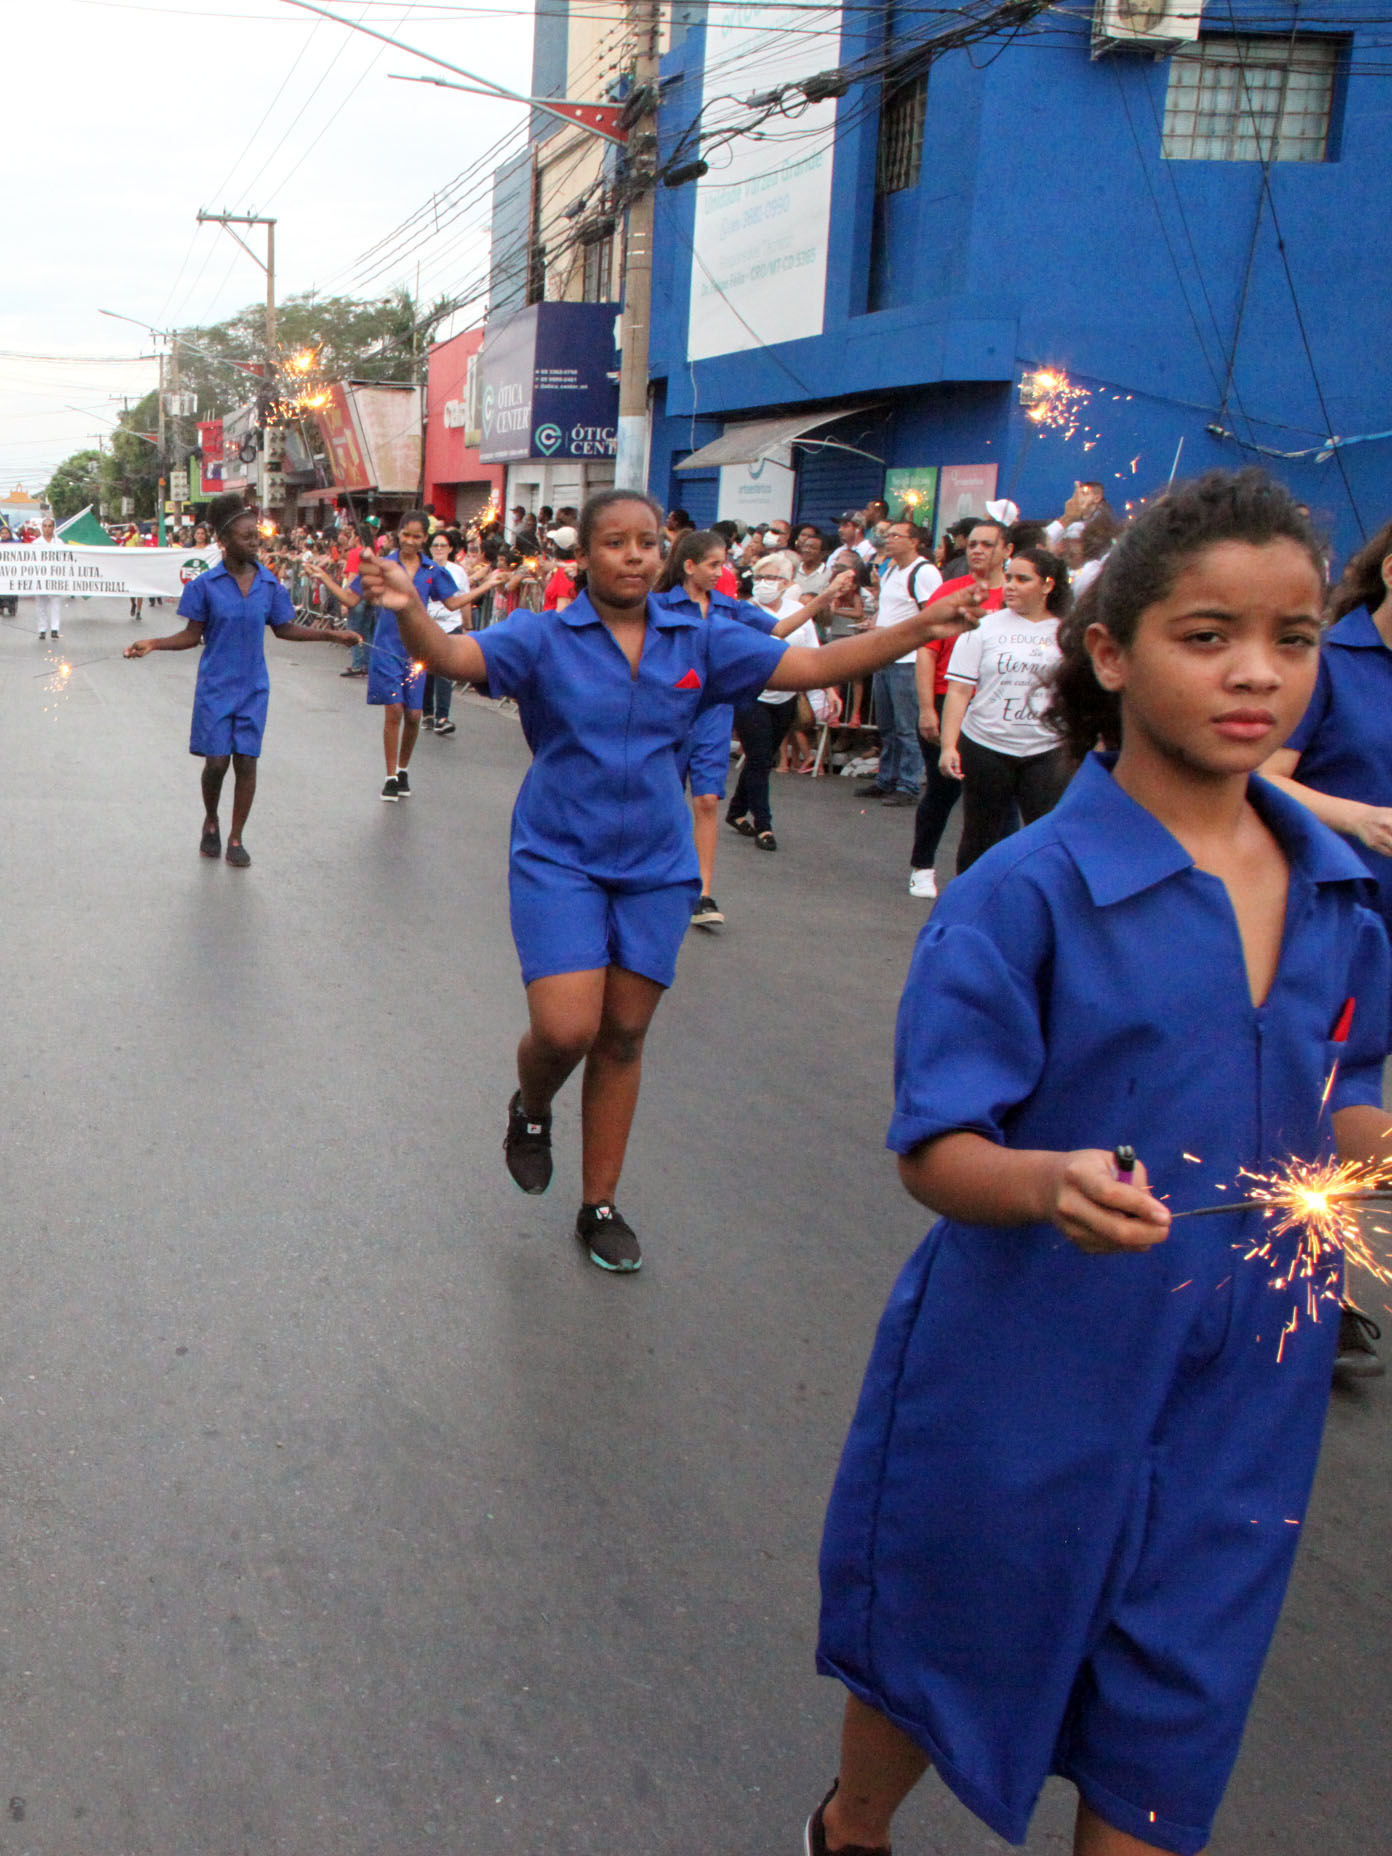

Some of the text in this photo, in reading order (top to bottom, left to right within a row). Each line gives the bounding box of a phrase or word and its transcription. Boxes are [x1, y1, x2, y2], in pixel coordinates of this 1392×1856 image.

[498, 383, 522, 408] ÓTICA
[496, 408, 529, 434] CENTER
[571, 423, 615, 441] ÓTIC
[570, 441, 617, 455] CENT
[41, 550, 77, 563] BRUTA,
[21, 565, 47, 576] POVO
[50, 565, 66, 576] FOI
[9, 580, 15, 590] E
[18, 580, 33, 590] FEZ
[36, 580, 42, 590] A
[45, 580, 70, 591] URBE
[998, 634, 1008, 645] O
[997, 652, 1049, 675] Eterni
